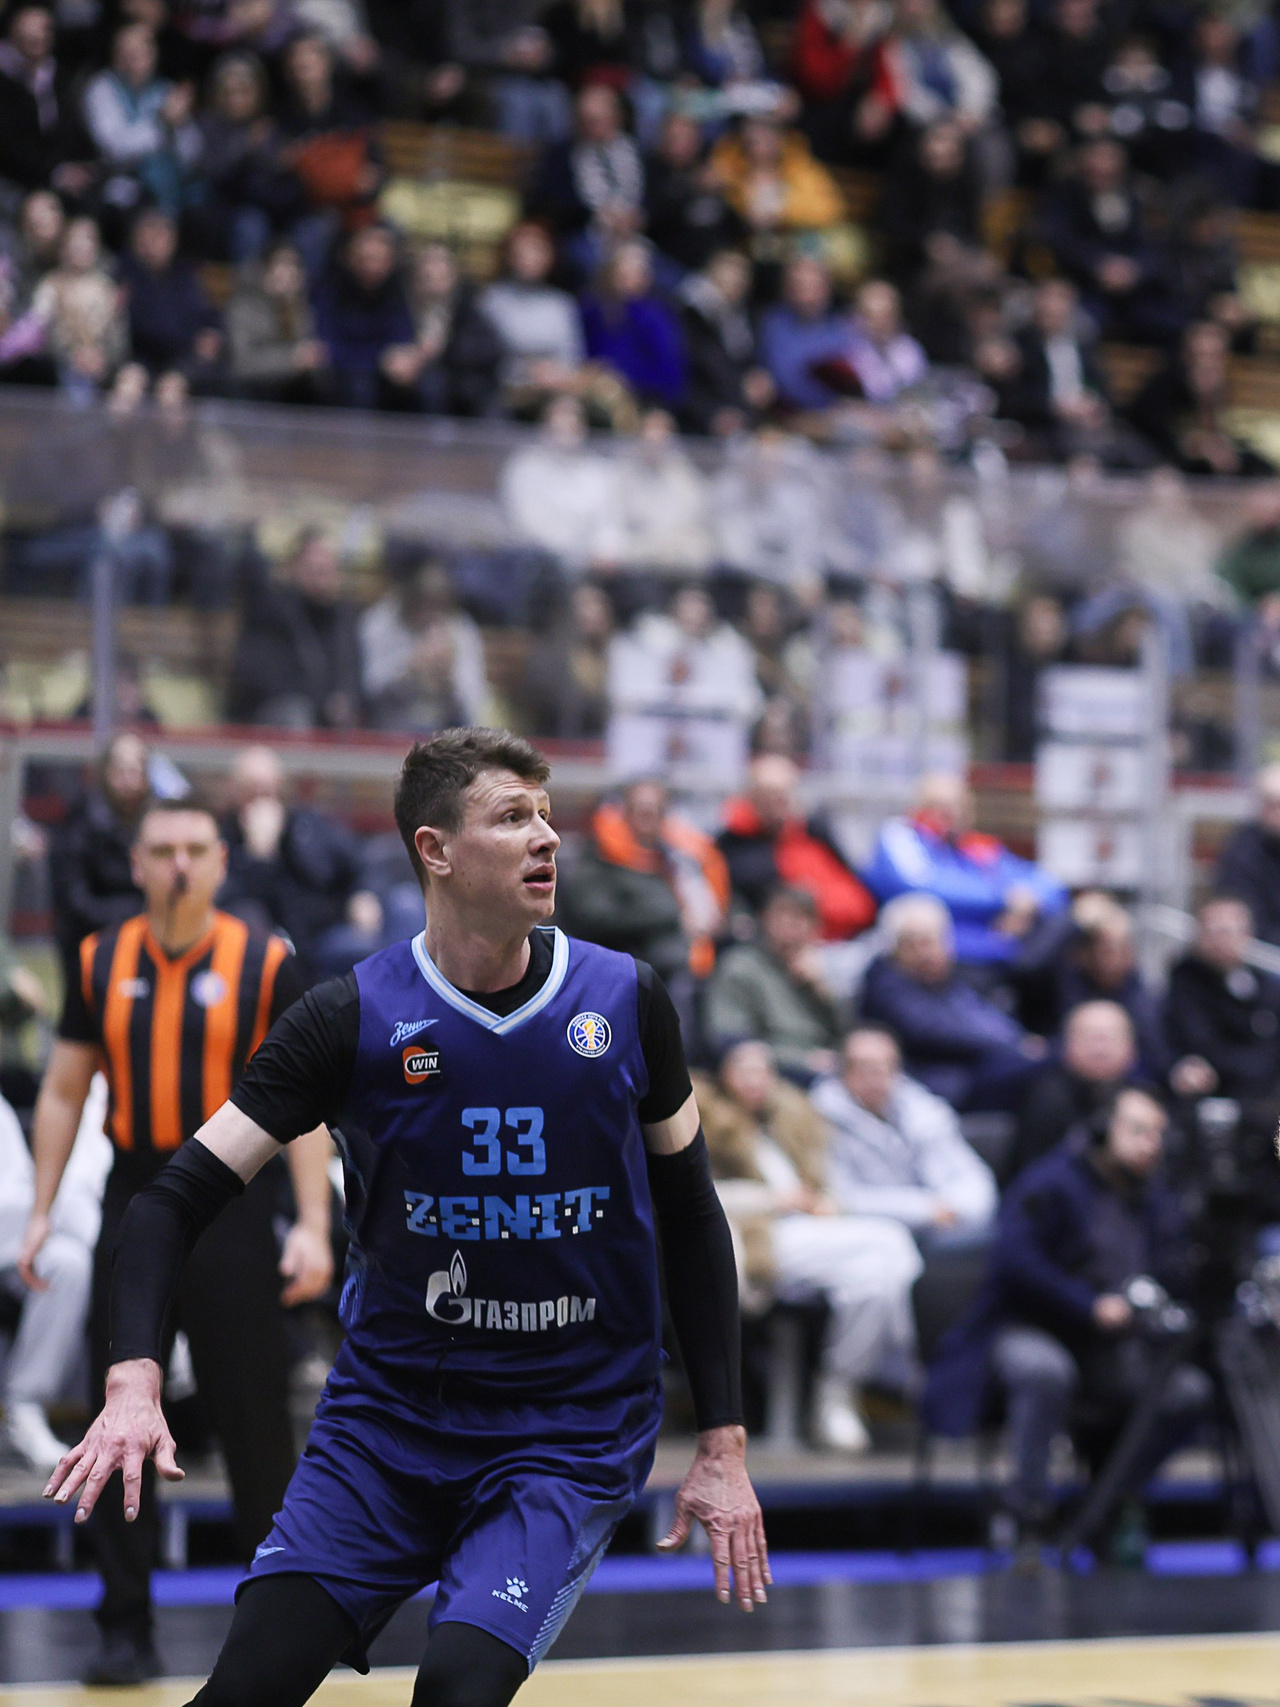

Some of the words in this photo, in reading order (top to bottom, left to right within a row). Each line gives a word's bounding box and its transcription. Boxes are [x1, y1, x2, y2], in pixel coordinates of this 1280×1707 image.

[412, 1057, 438, 1071] WIN
[461, 1106, 547, 1176] 33
[404, 1186, 611, 1241] ZENIT
[473, 1296, 597, 1332] ГАЗПРОМ
[491, 1589, 529, 1613] KELME
